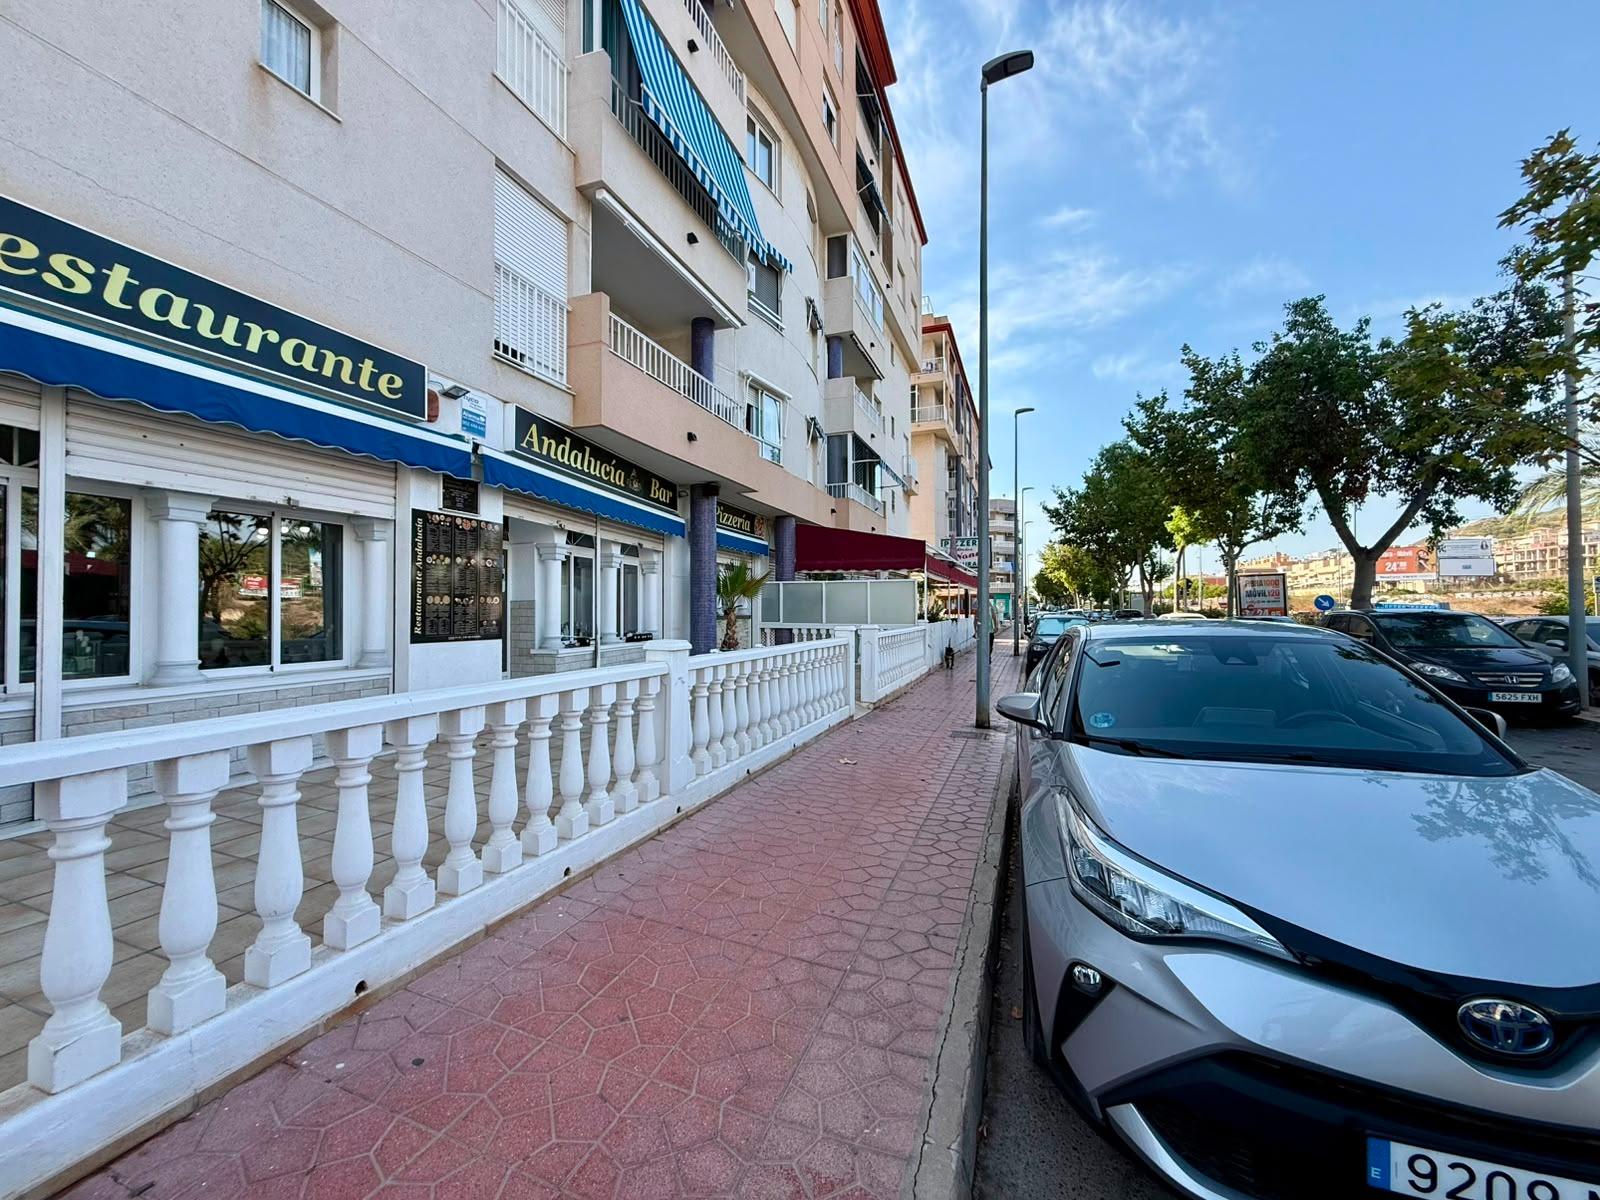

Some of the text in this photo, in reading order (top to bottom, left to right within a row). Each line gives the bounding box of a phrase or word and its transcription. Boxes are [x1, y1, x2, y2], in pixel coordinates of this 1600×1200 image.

[520, 423, 673, 504] Andalucía Bar
[943, 539, 978, 547] PZER
[414, 517, 423, 634] Restaurante Andalucía
[1495, 693, 1519, 701] 5625
[1370, 1166, 1382, 1180] E
